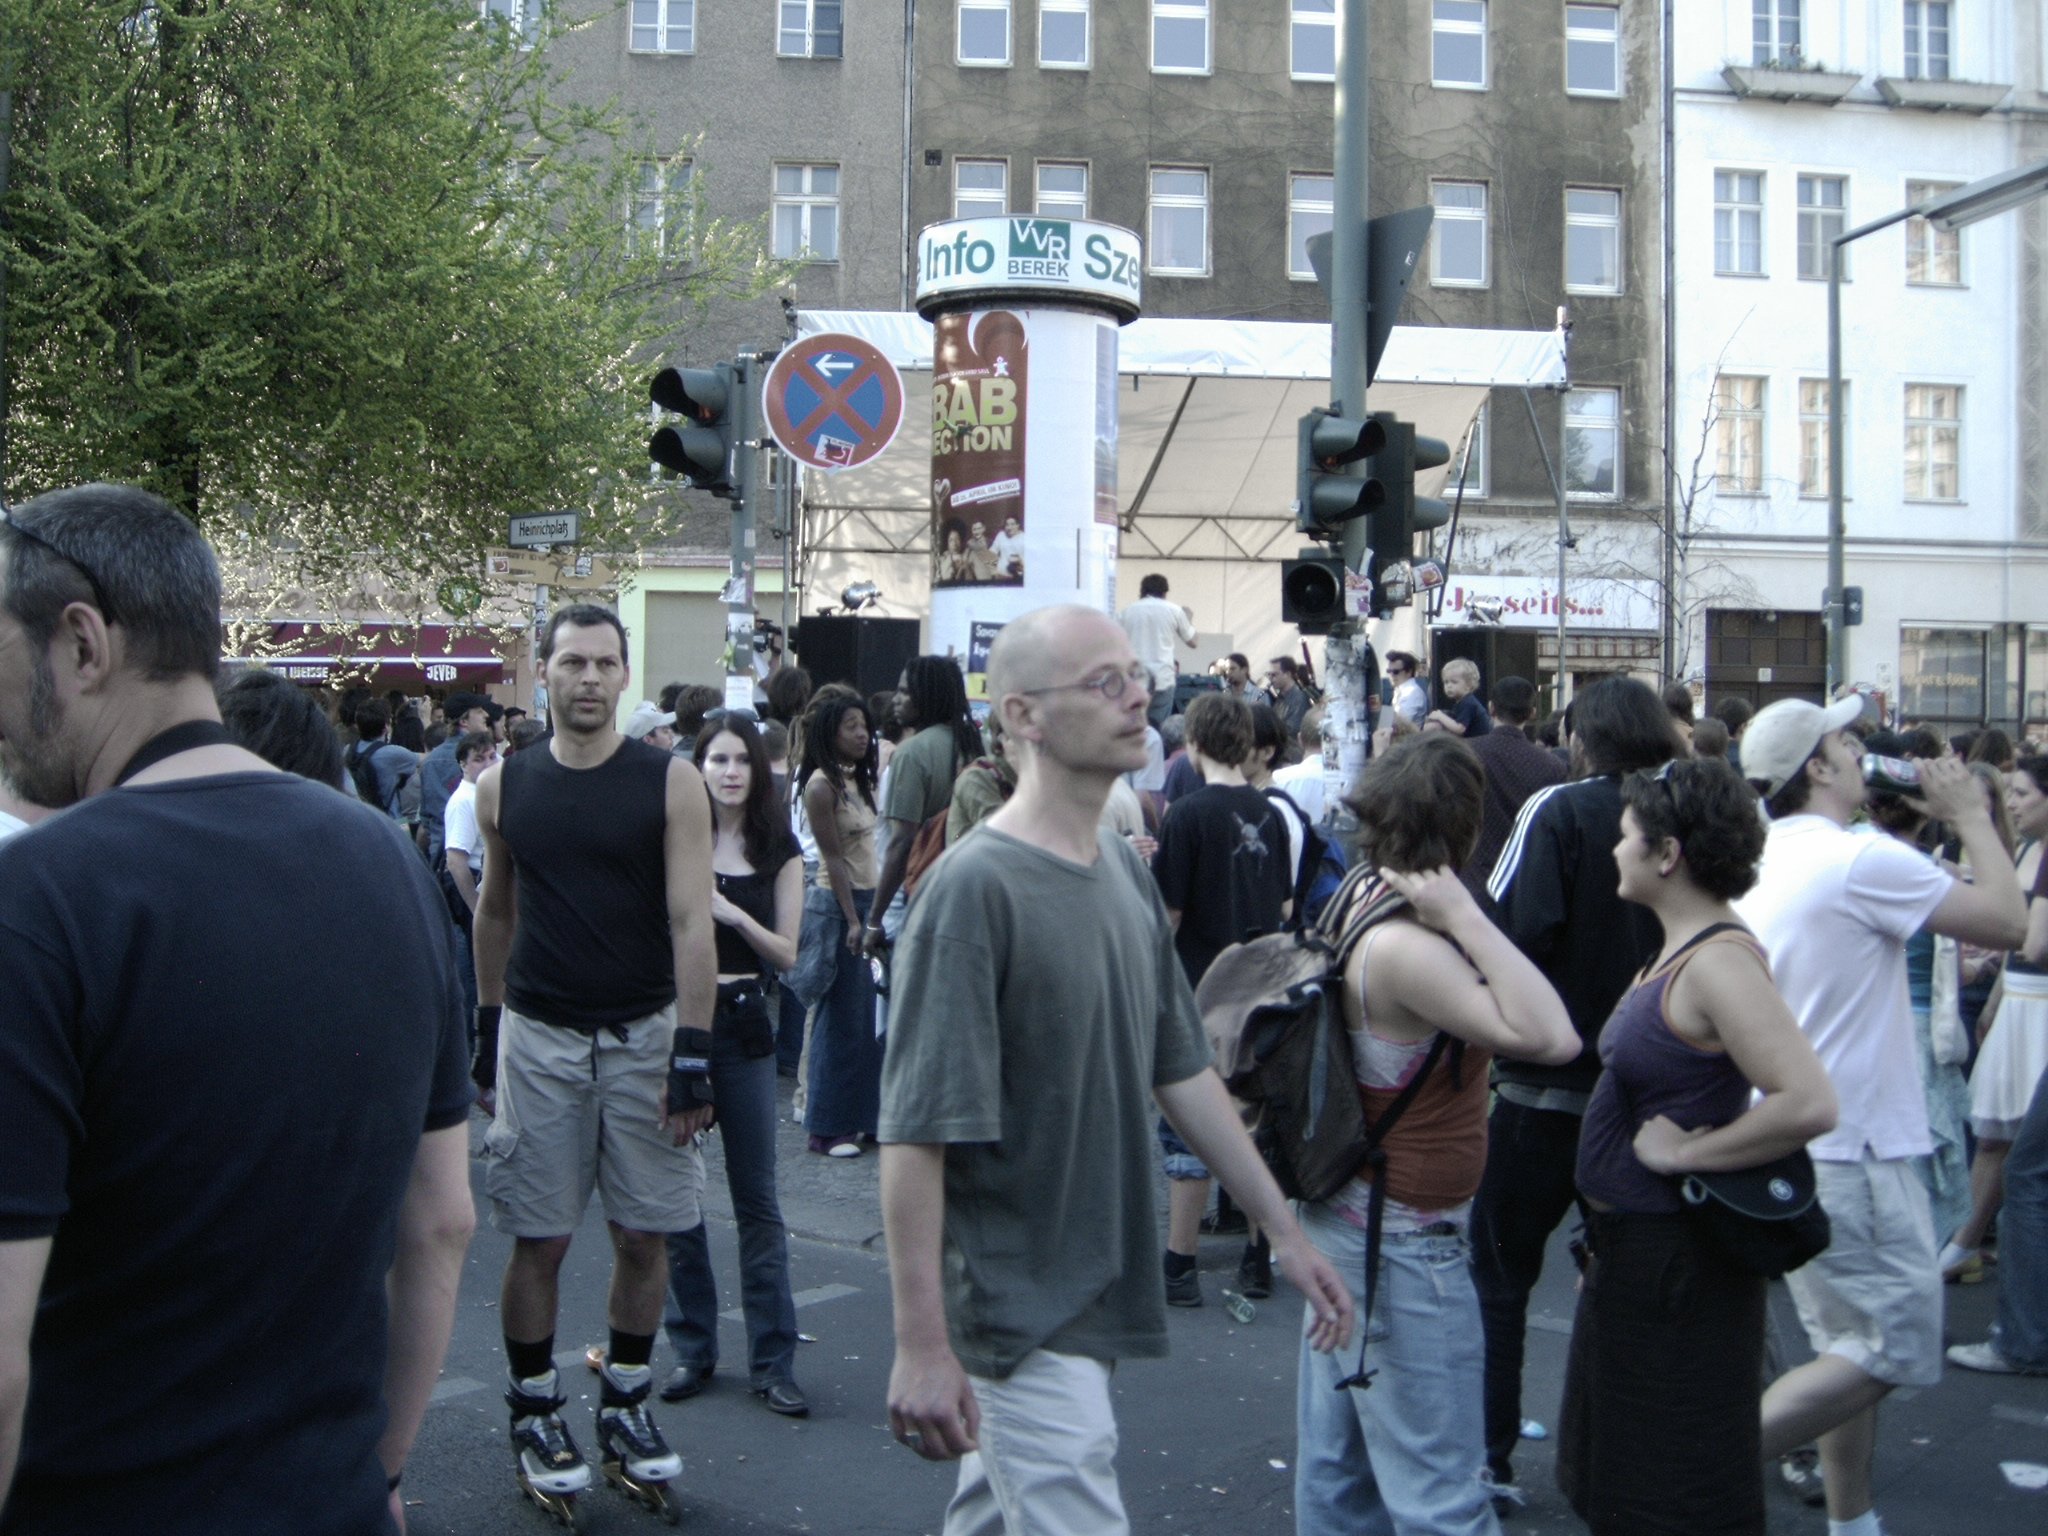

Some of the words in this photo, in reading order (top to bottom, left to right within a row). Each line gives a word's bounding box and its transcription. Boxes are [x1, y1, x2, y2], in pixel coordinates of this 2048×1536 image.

[926, 230, 995, 281] Info
[1008, 260, 1069, 277] BEREK
[932, 377, 1017, 431] BAB
[933, 425, 1012, 456] ECION
[426, 664, 457, 682] JEVER
